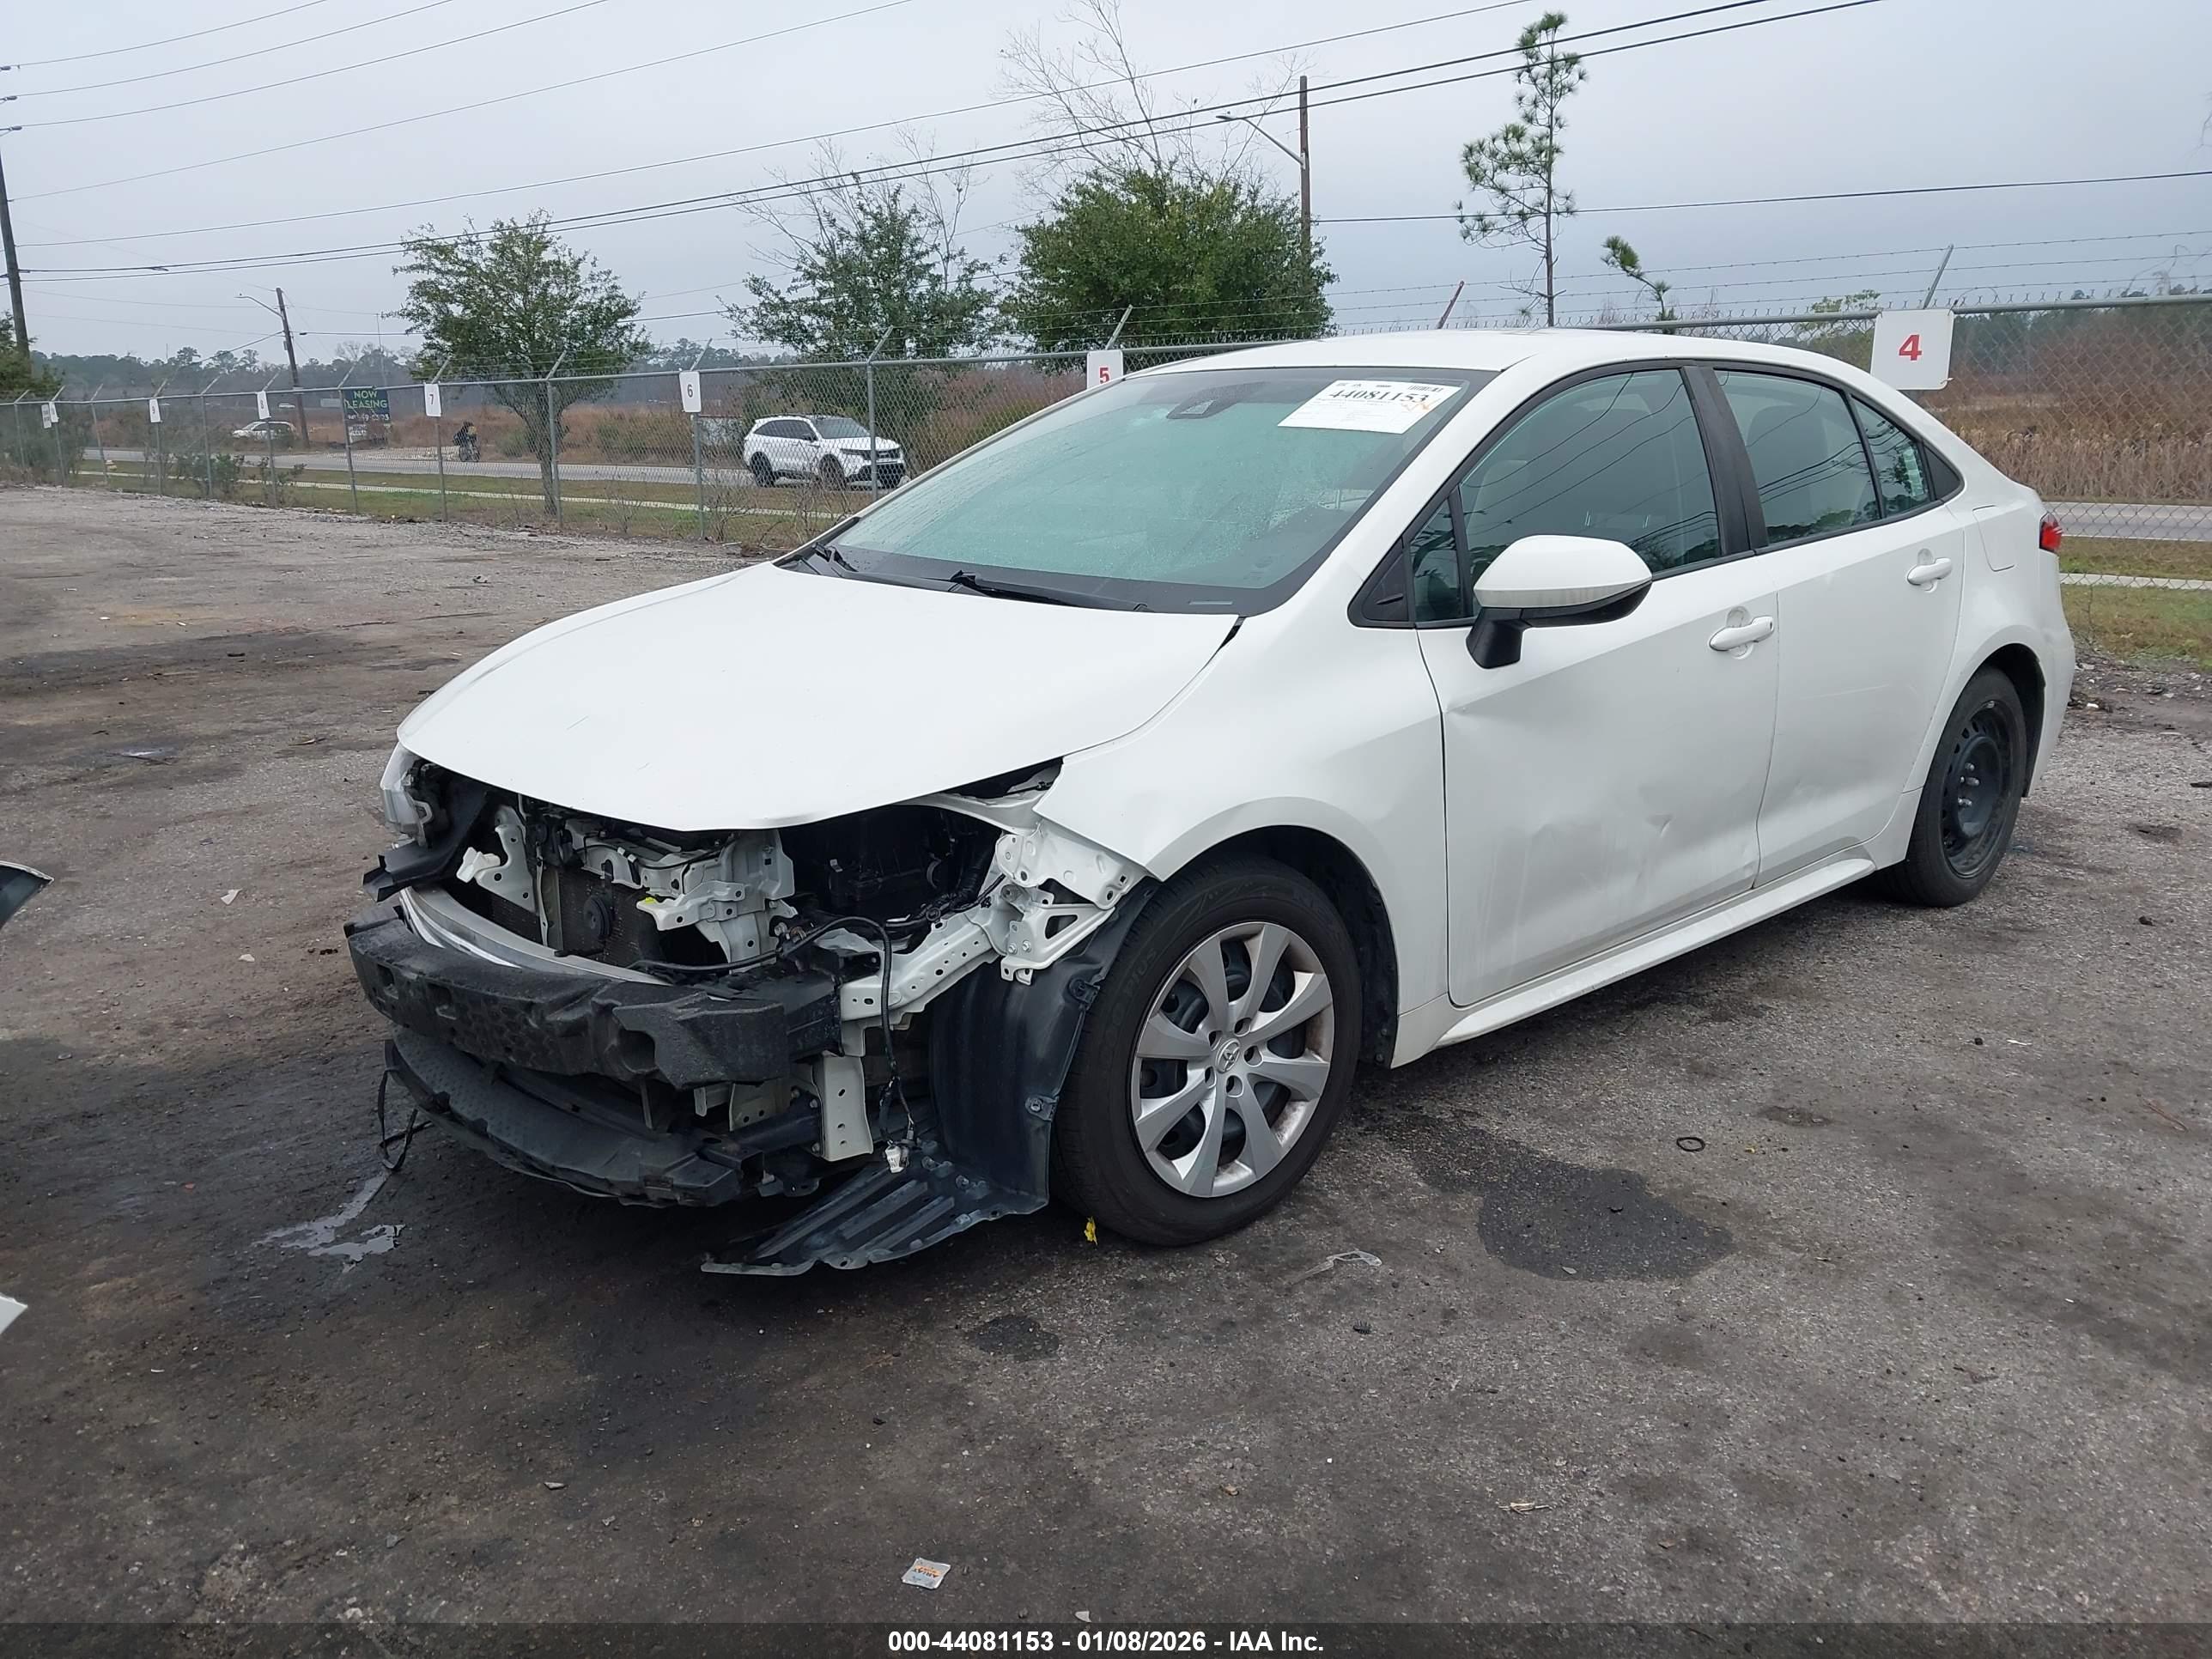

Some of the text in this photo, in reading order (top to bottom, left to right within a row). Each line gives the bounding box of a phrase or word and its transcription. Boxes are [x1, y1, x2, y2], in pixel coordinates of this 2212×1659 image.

[1898, 334, 1923, 362] 4
[1099, 367, 1109, 384] 5
[353, 390, 378, 399] NOW
[687, 384, 693, 398] 6
[1328, 390, 1430, 403] 44081153
[346, 399, 388, 410] LEASING
[428, 393, 434, 405] 7
